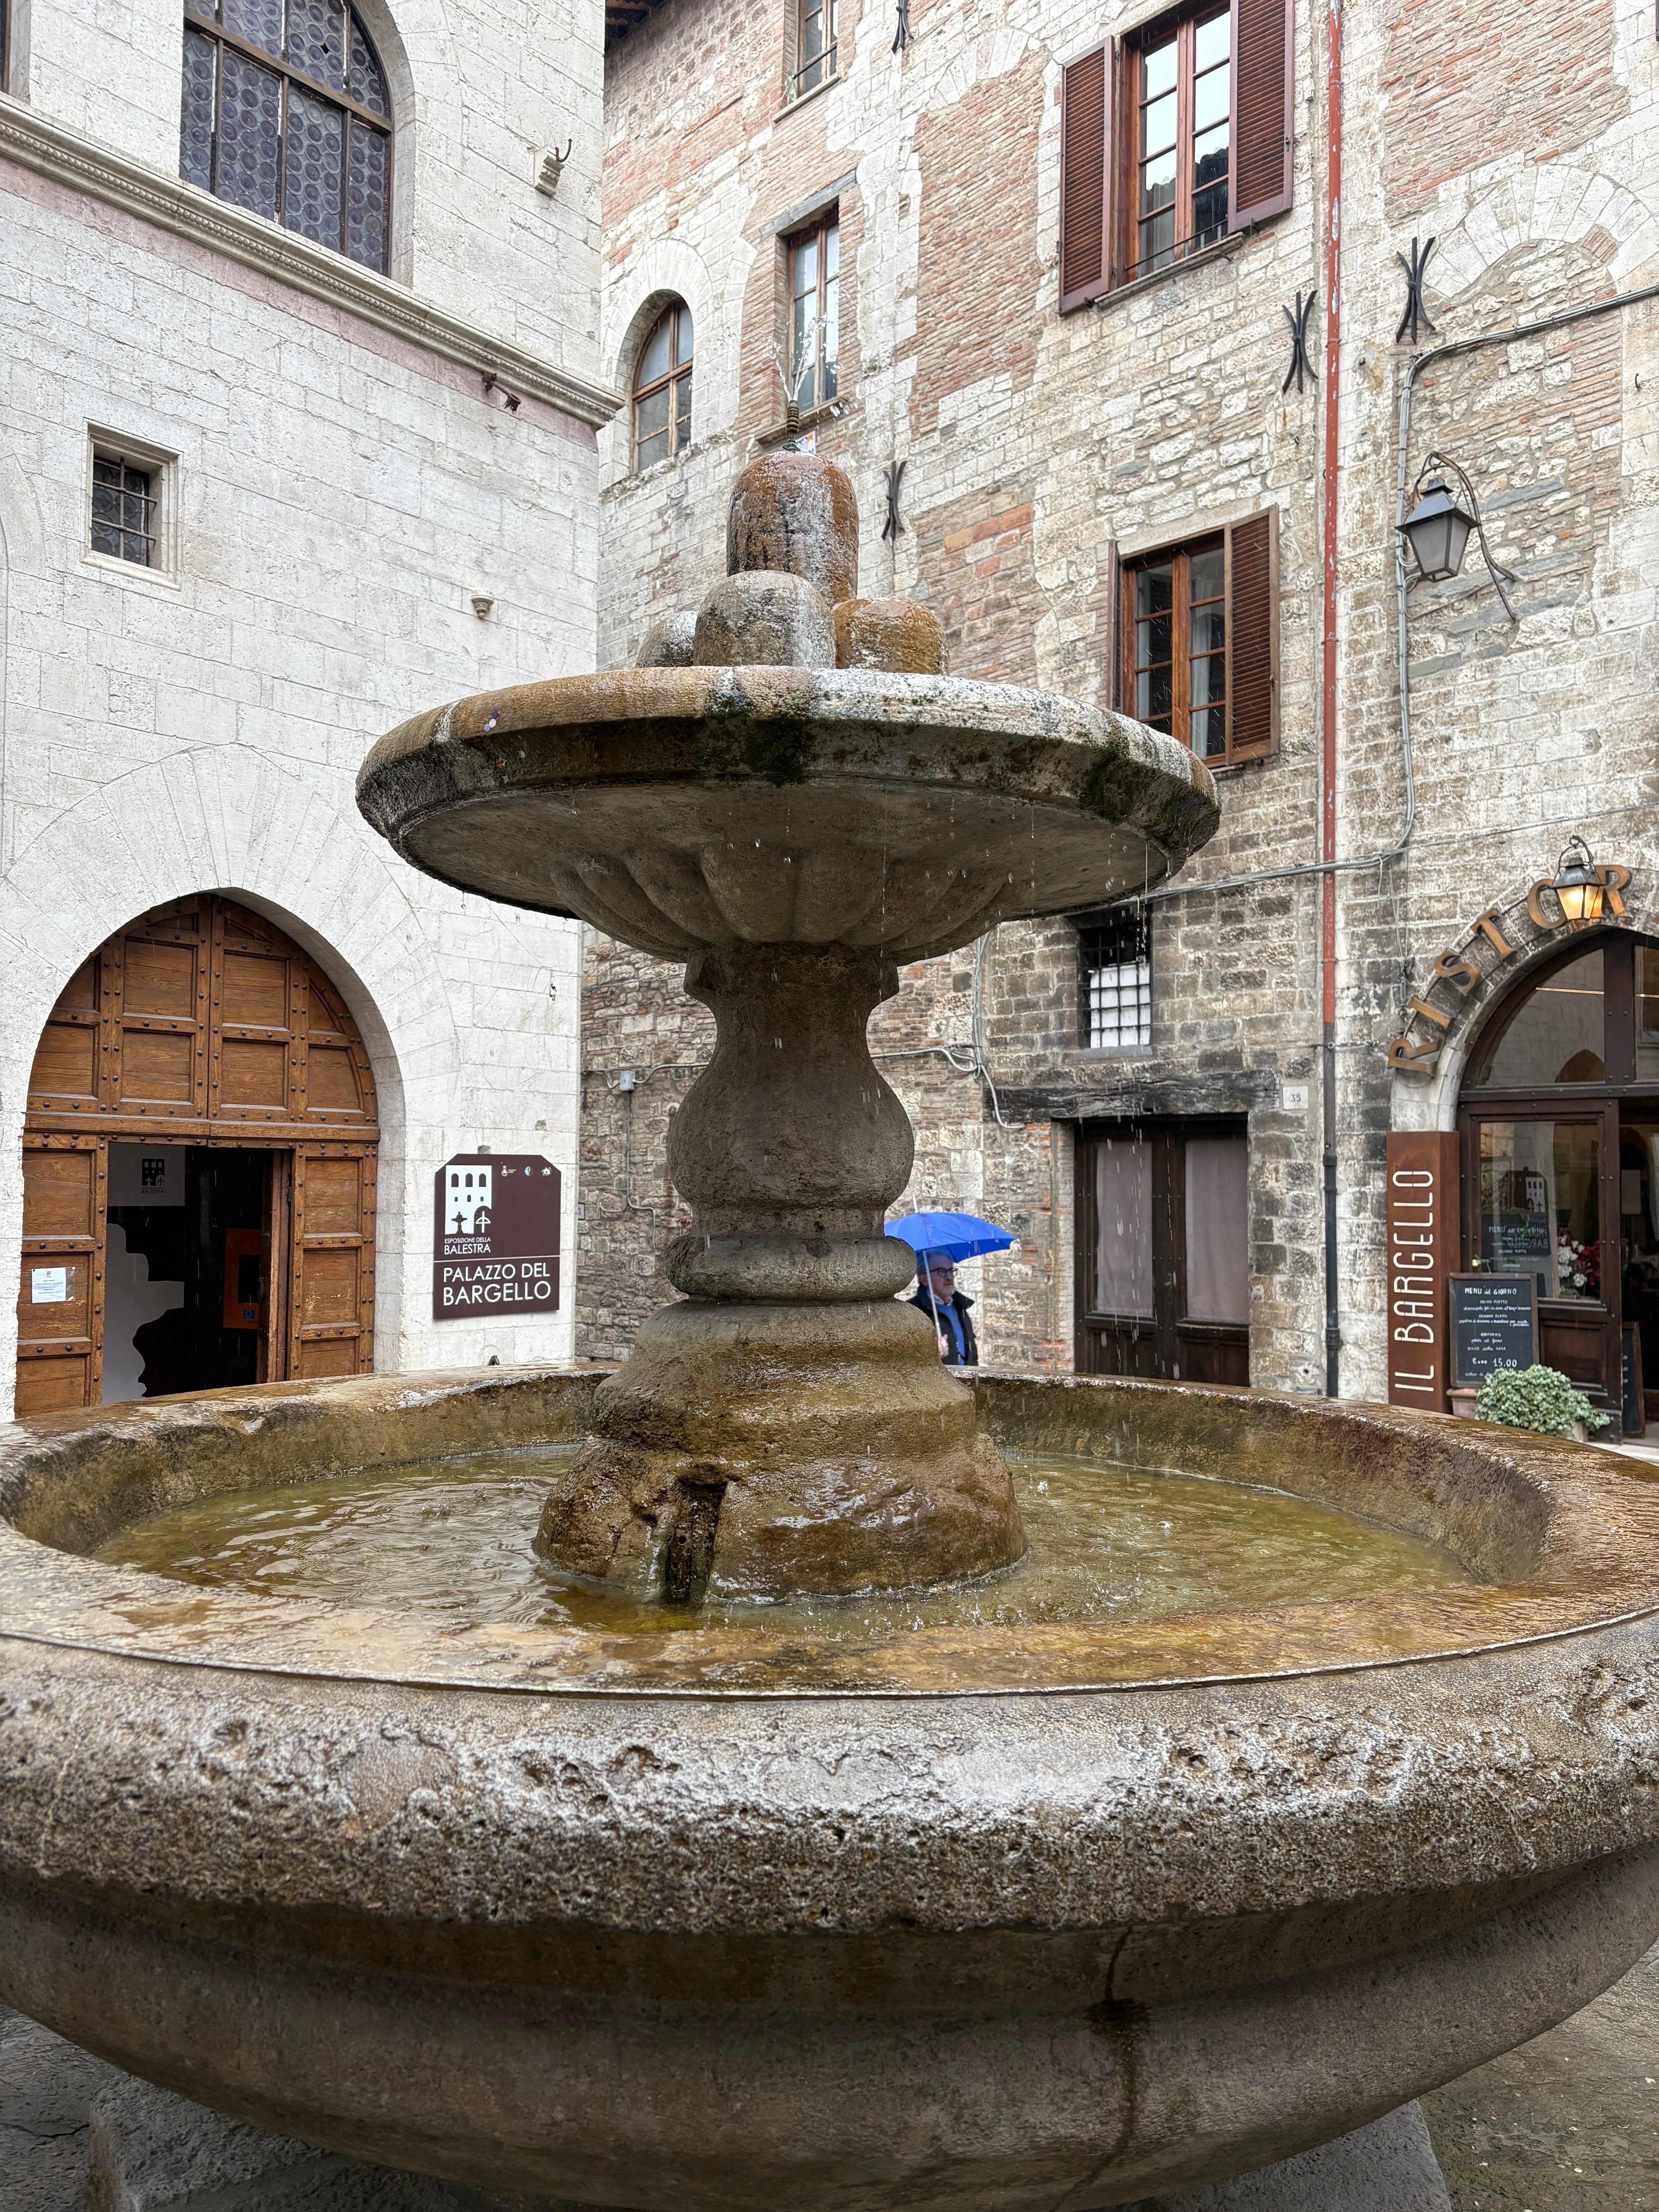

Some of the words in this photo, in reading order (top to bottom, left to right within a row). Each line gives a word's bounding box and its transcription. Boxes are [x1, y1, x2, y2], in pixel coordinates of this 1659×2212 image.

[1387, 865, 1659, 1079] RISTOR
[444, 1243, 491, 1255] BALESTRA
[1393, 1170, 1434, 1343] BARGELLO
[443, 1264, 515, 1283] PALAZZO
[522, 1262, 550, 1278] DEL
[443, 1280, 551, 1306] BARGELLO
[1493, 1357, 1517, 1368] 15.00
[1395, 1365, 1434, 1391] IL
